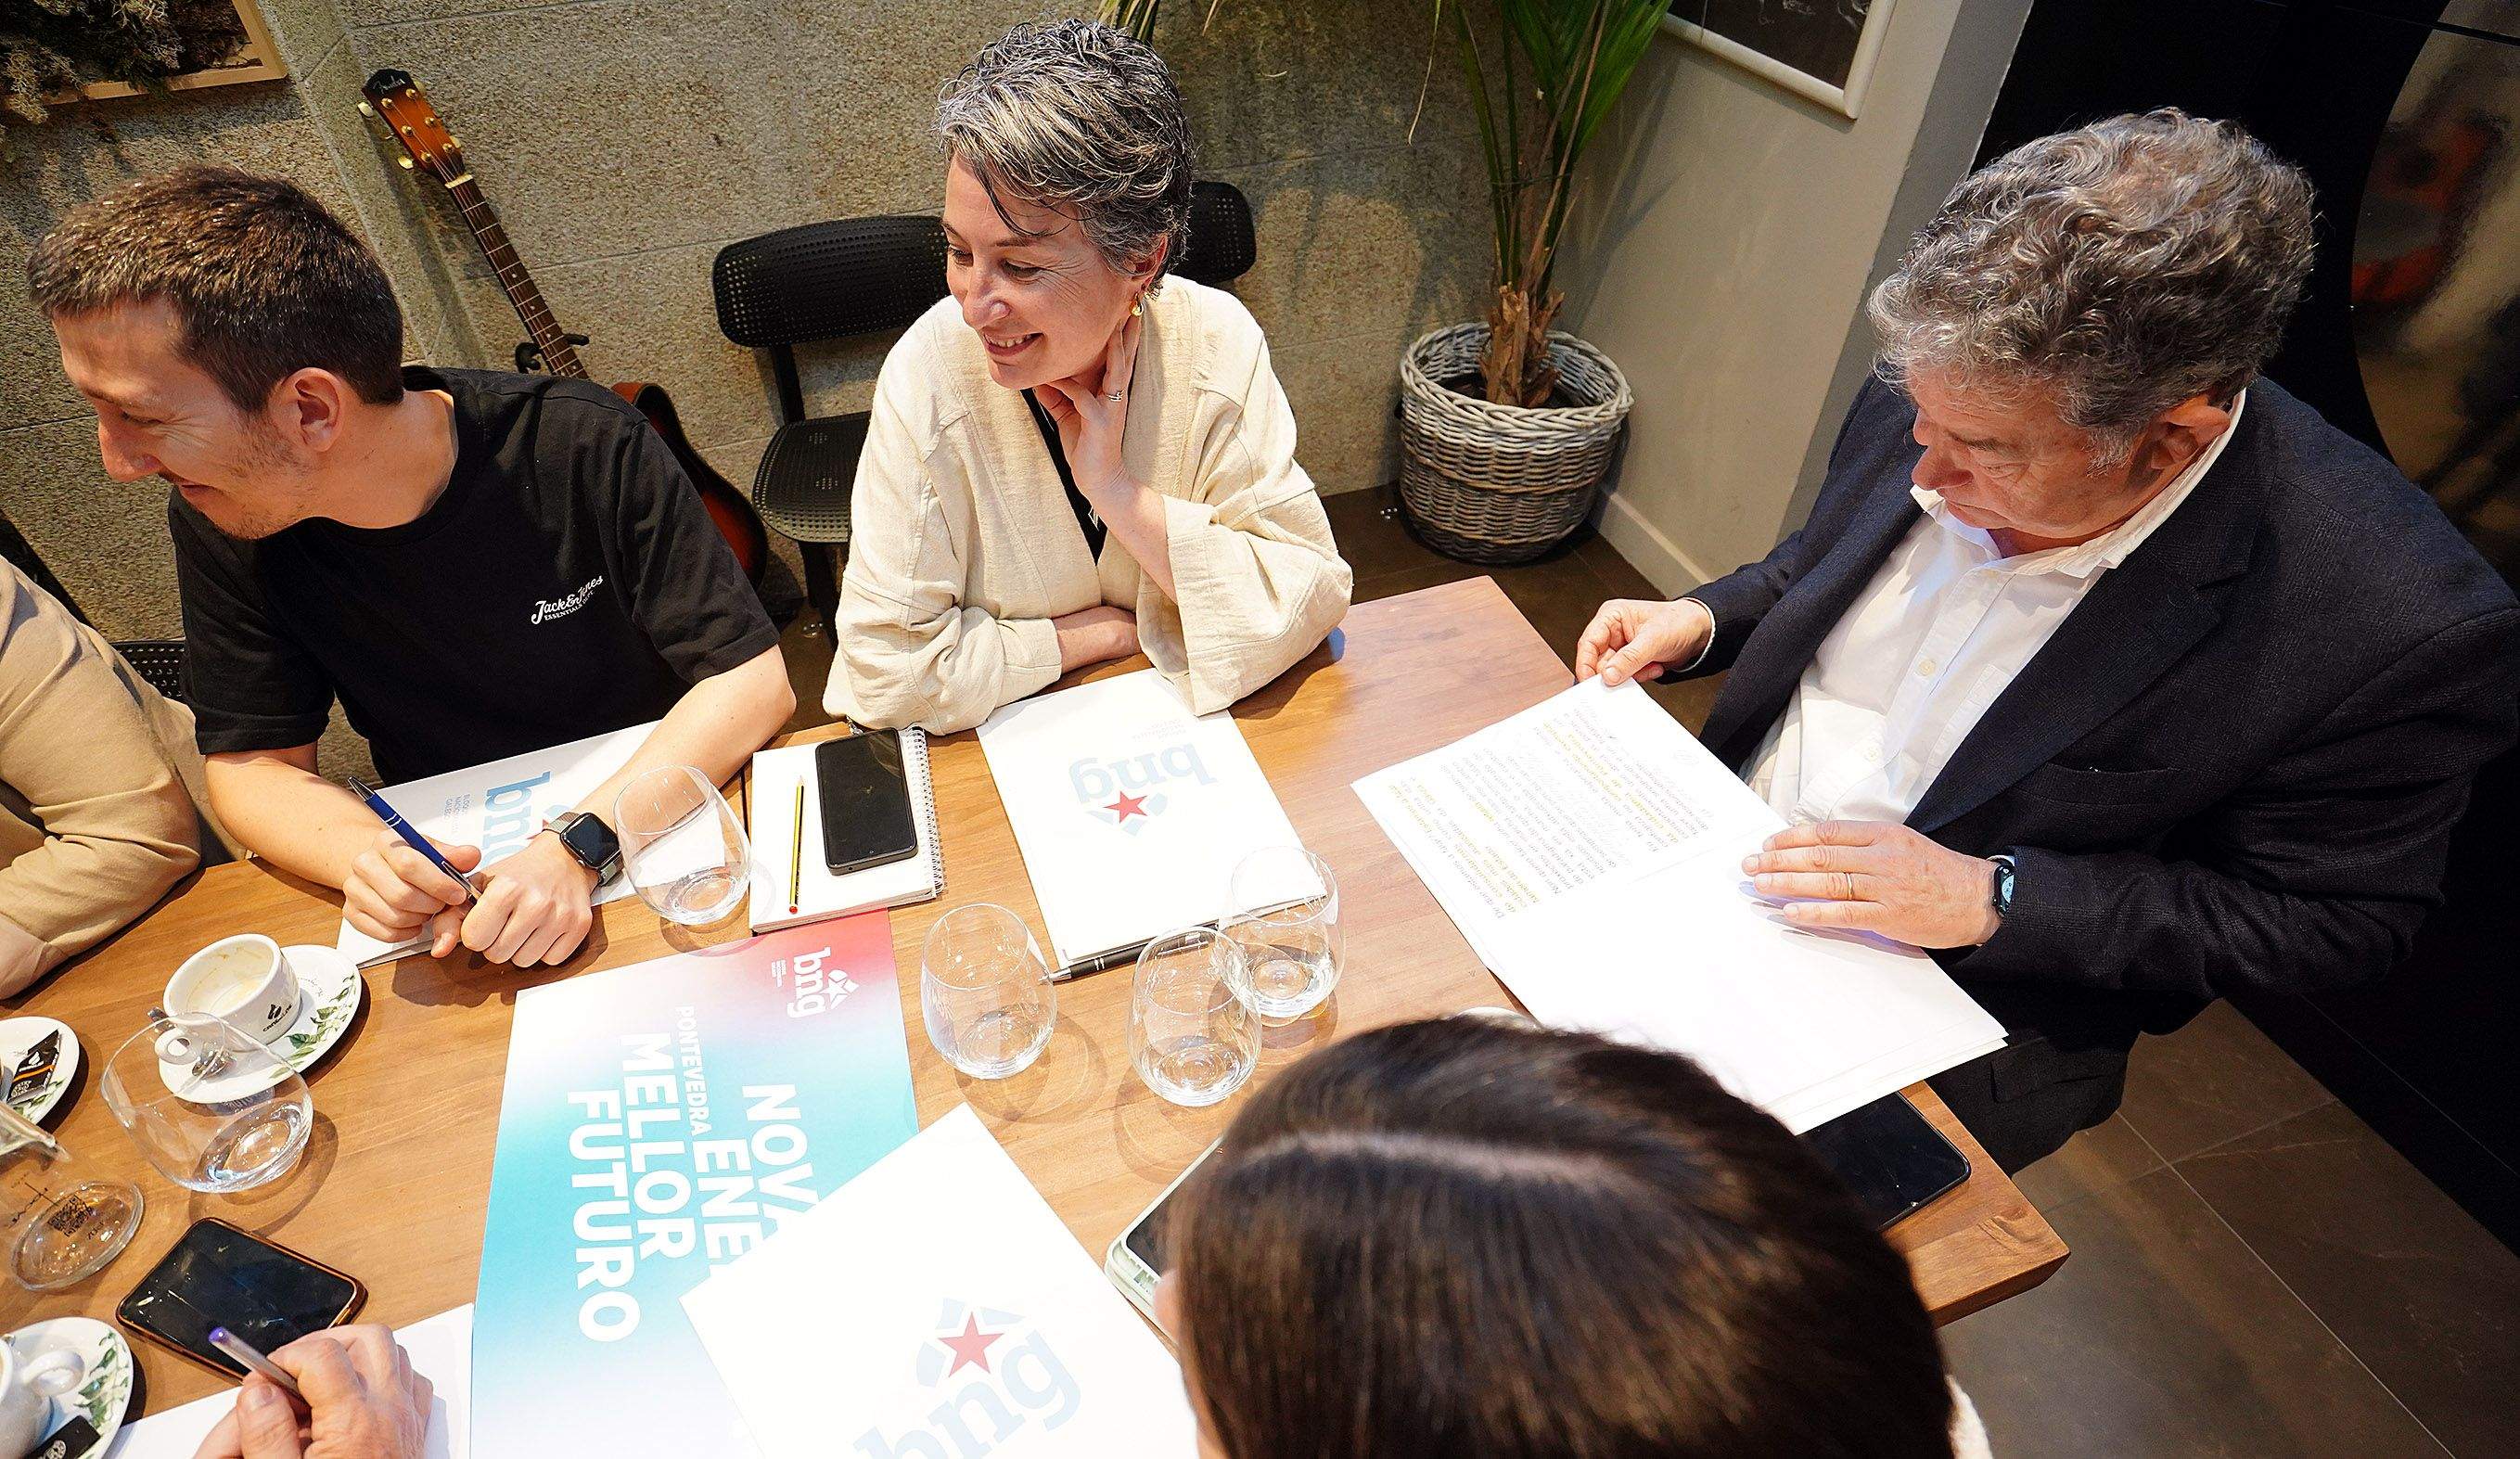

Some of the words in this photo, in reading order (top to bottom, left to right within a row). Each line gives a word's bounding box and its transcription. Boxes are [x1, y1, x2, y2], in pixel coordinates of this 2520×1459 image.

[1068, 742, 1218, 804] bng
[786, 946, 831, 1018] bng
[675, 1005, 713, 1137] PONTEVEDRA
[620, 1030, 697, 1261] MELLOR
[692, 1138, 764, 1273] ENE
[567, 1089, 642, 1342] FUTURO
